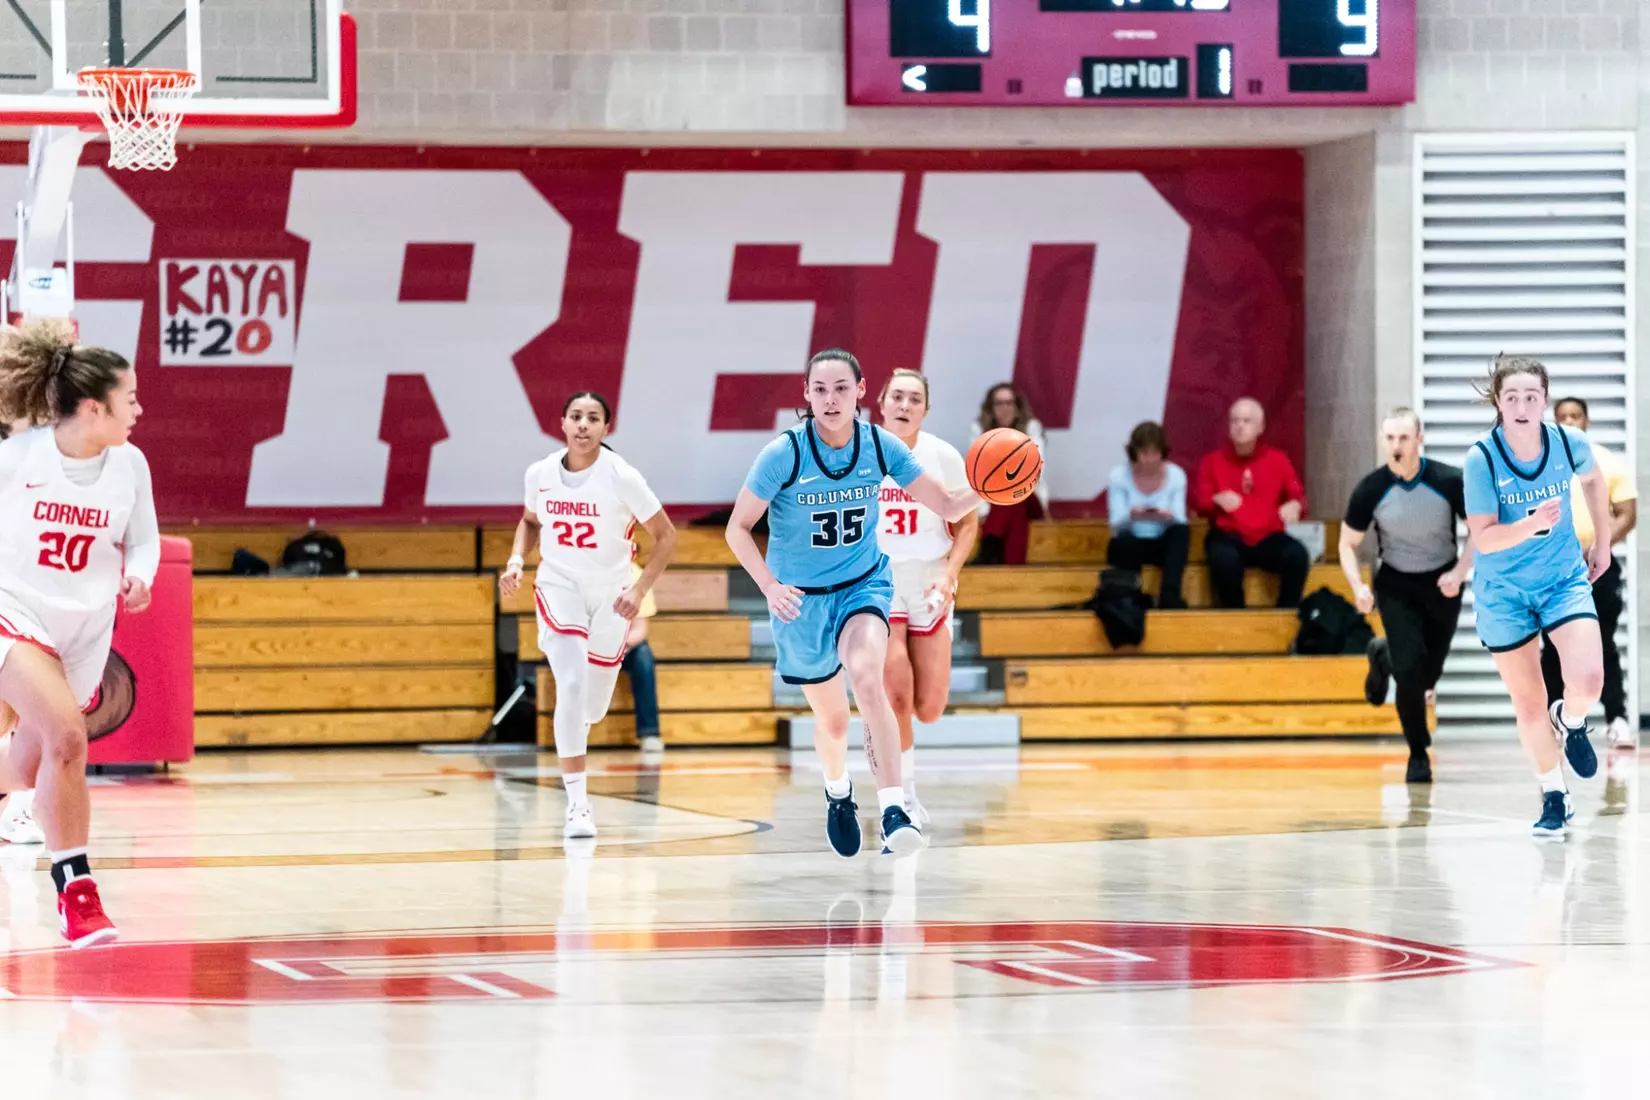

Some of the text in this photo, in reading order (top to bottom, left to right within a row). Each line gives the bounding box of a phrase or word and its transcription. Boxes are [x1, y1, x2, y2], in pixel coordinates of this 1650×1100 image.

[1336, 0, 1378, 56] 9
[1093, 48, 1231, 95] period 1
[166, 262, 288, 319] KAYA
[164, 317, 272, 357] #20
[245, 169, 1192, 507] RED
[546, 500, 601, 517] CORNELL
[797, 484, 879, 505] COLUMBIA
[1500, 480, 1569, 504] COLUMBIA
[33, 500, 109, 529] CORNELL
[810, 505, 868, 549] 35
[885, 508, 918, 536] 31
[38, 531, 96, 574] 20
[552, 521, 598, 550] 22
